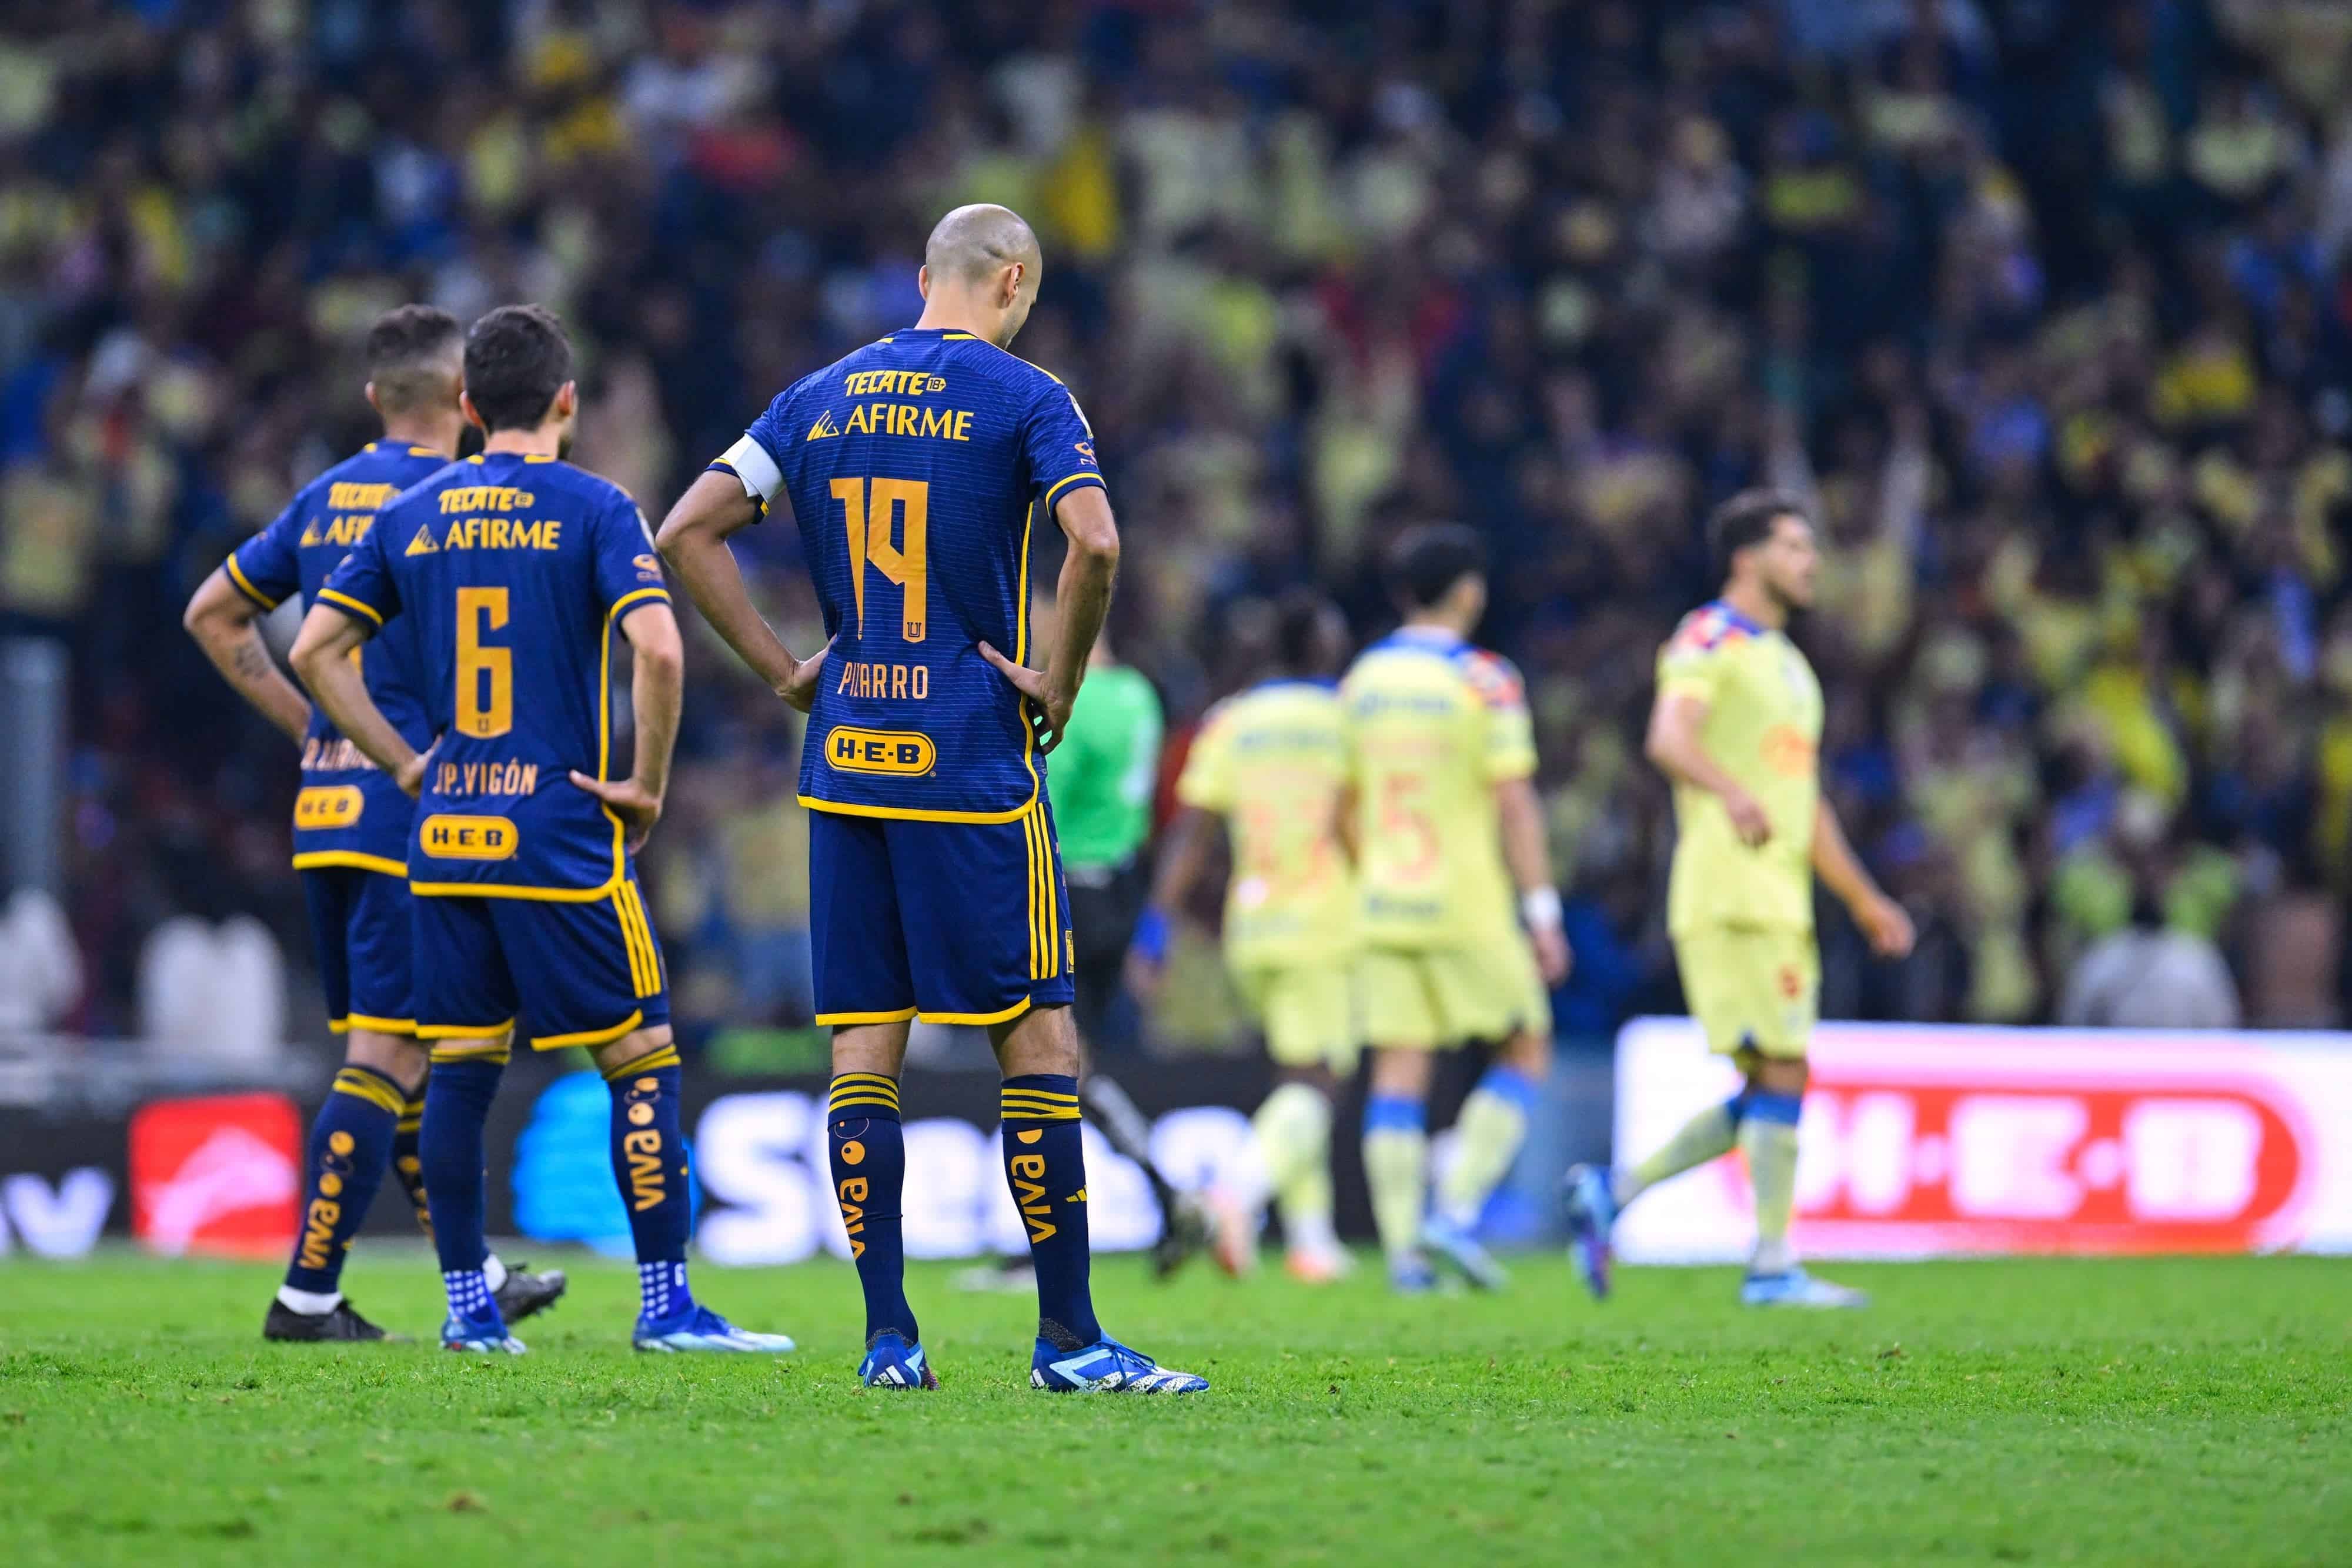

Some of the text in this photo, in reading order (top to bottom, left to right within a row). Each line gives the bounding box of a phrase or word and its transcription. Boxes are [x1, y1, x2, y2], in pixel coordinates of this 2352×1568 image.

[844, 370, 931, 397] TECATE
[844, 403, 974, 441] AFIRME
[438, 486, 518, 514] TECATE
[444, 518, 562, 550] AFIRME
[830, 477, 928, 643] 19
[456, 587, 513, 739] 6
[624, 1129, 666, 1212] viva
[1011, 1154, 1057, 1244] viva
